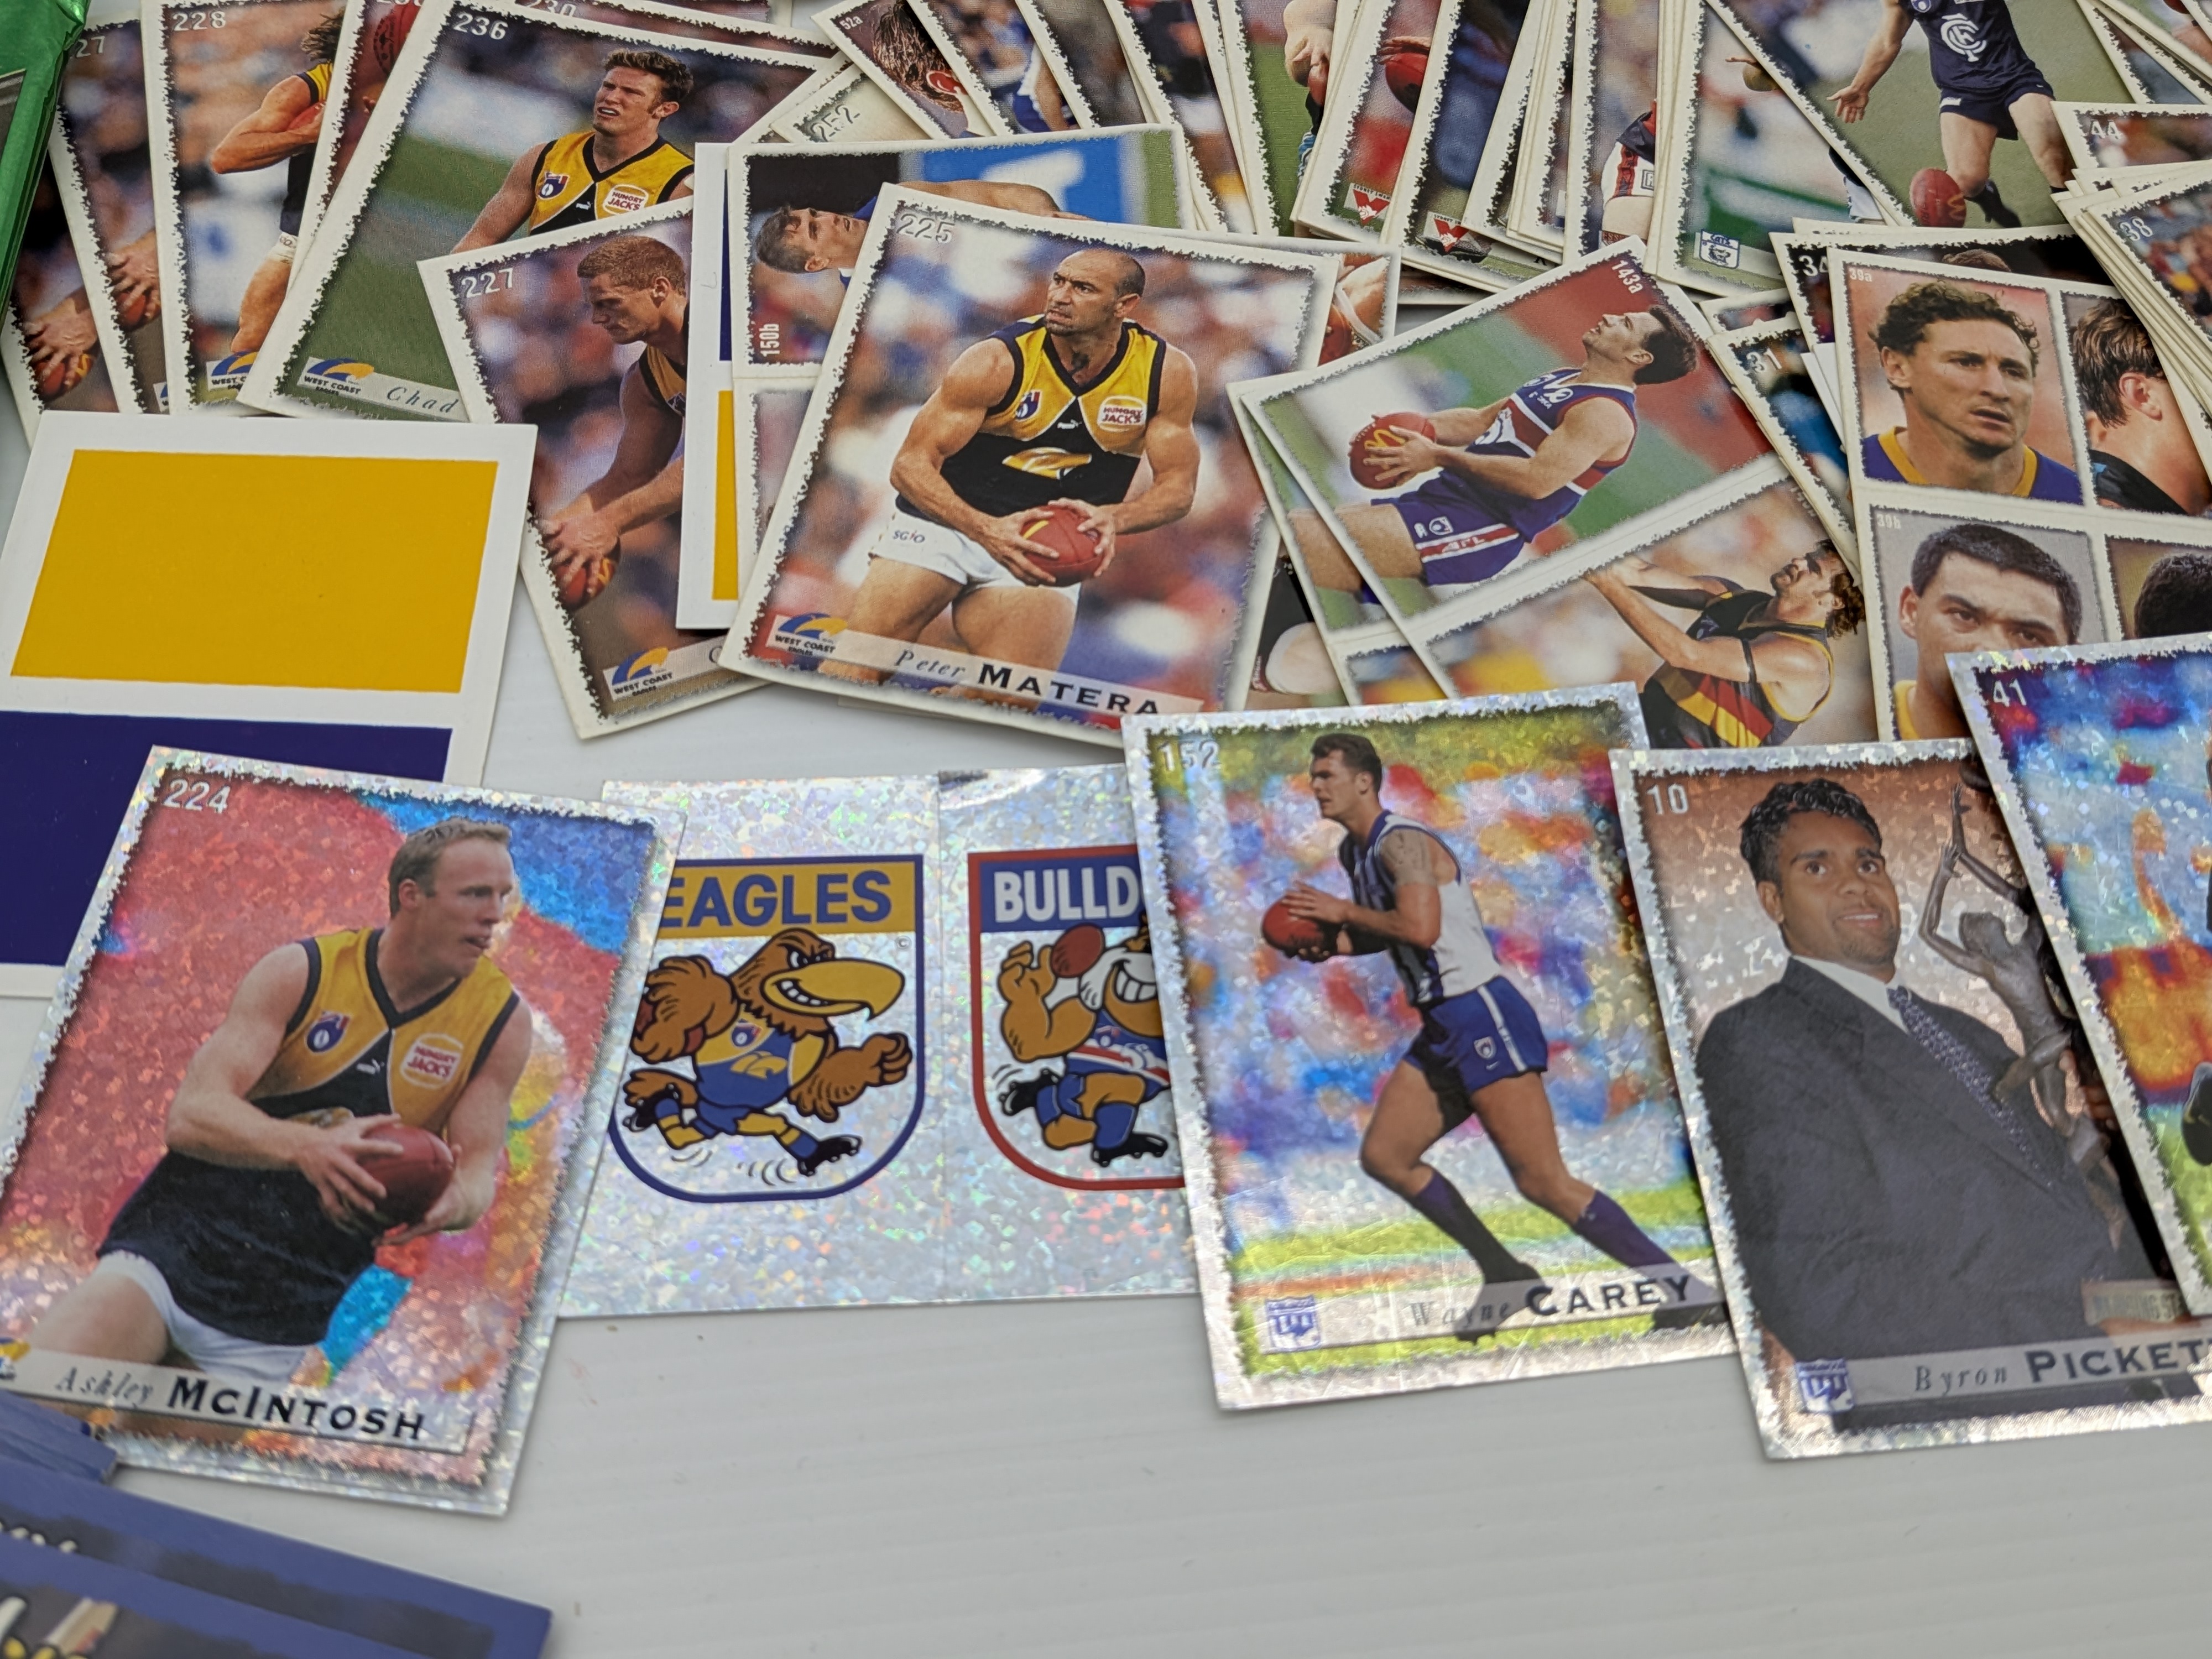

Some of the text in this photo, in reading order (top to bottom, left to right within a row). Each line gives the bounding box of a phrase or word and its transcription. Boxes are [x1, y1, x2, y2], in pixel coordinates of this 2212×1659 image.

[172, 11, 227, 32] 228
[452, 11, 508, 40] 236
[839, 15, 864, 30] 52a
[810, 104, 861, 143] 252
[2089, 119, 2120, 139] 44
[612, 191, 644, 204] HUNGRY
[896, 212, 956, 243] 225
[2120, 216, 2153, 242] 38
[1611, 259, 1644, 294] 143a
[1798, 254, 1829, 277] 34
[1848, 267, 1873, 283] 39a
[462, 267, 514, 298] 227
[759, 324, 781, 357] 150b
[1746, 347, 1782, 374] 31
[211, 377, 237, 385] WEST
[304, 375, 362, 395] WEST COAST
[387, 387, 460, 414] Chad
[775, 635, 836, 654] WEST COAST
[614, 672, 673, 695] WEST COAST
[895, 649, 1159, 714] Peter MATERA
[1992, 678, 2027, 707] 41
[1157, 740, 1222, 771] 152
[163, 776, 231, 814] 224
[1646, 783, 1689, 815] 10
[659, 870, 893, 927] EAGLES
[994, 865, 1147, 923] BULLD
[1411, 1274, 1690, 1327] Wayne CAREY
[1915, 1337, 2212, 1395] Byron PICKET
[54, 1367, 154, 1409] Ashley
